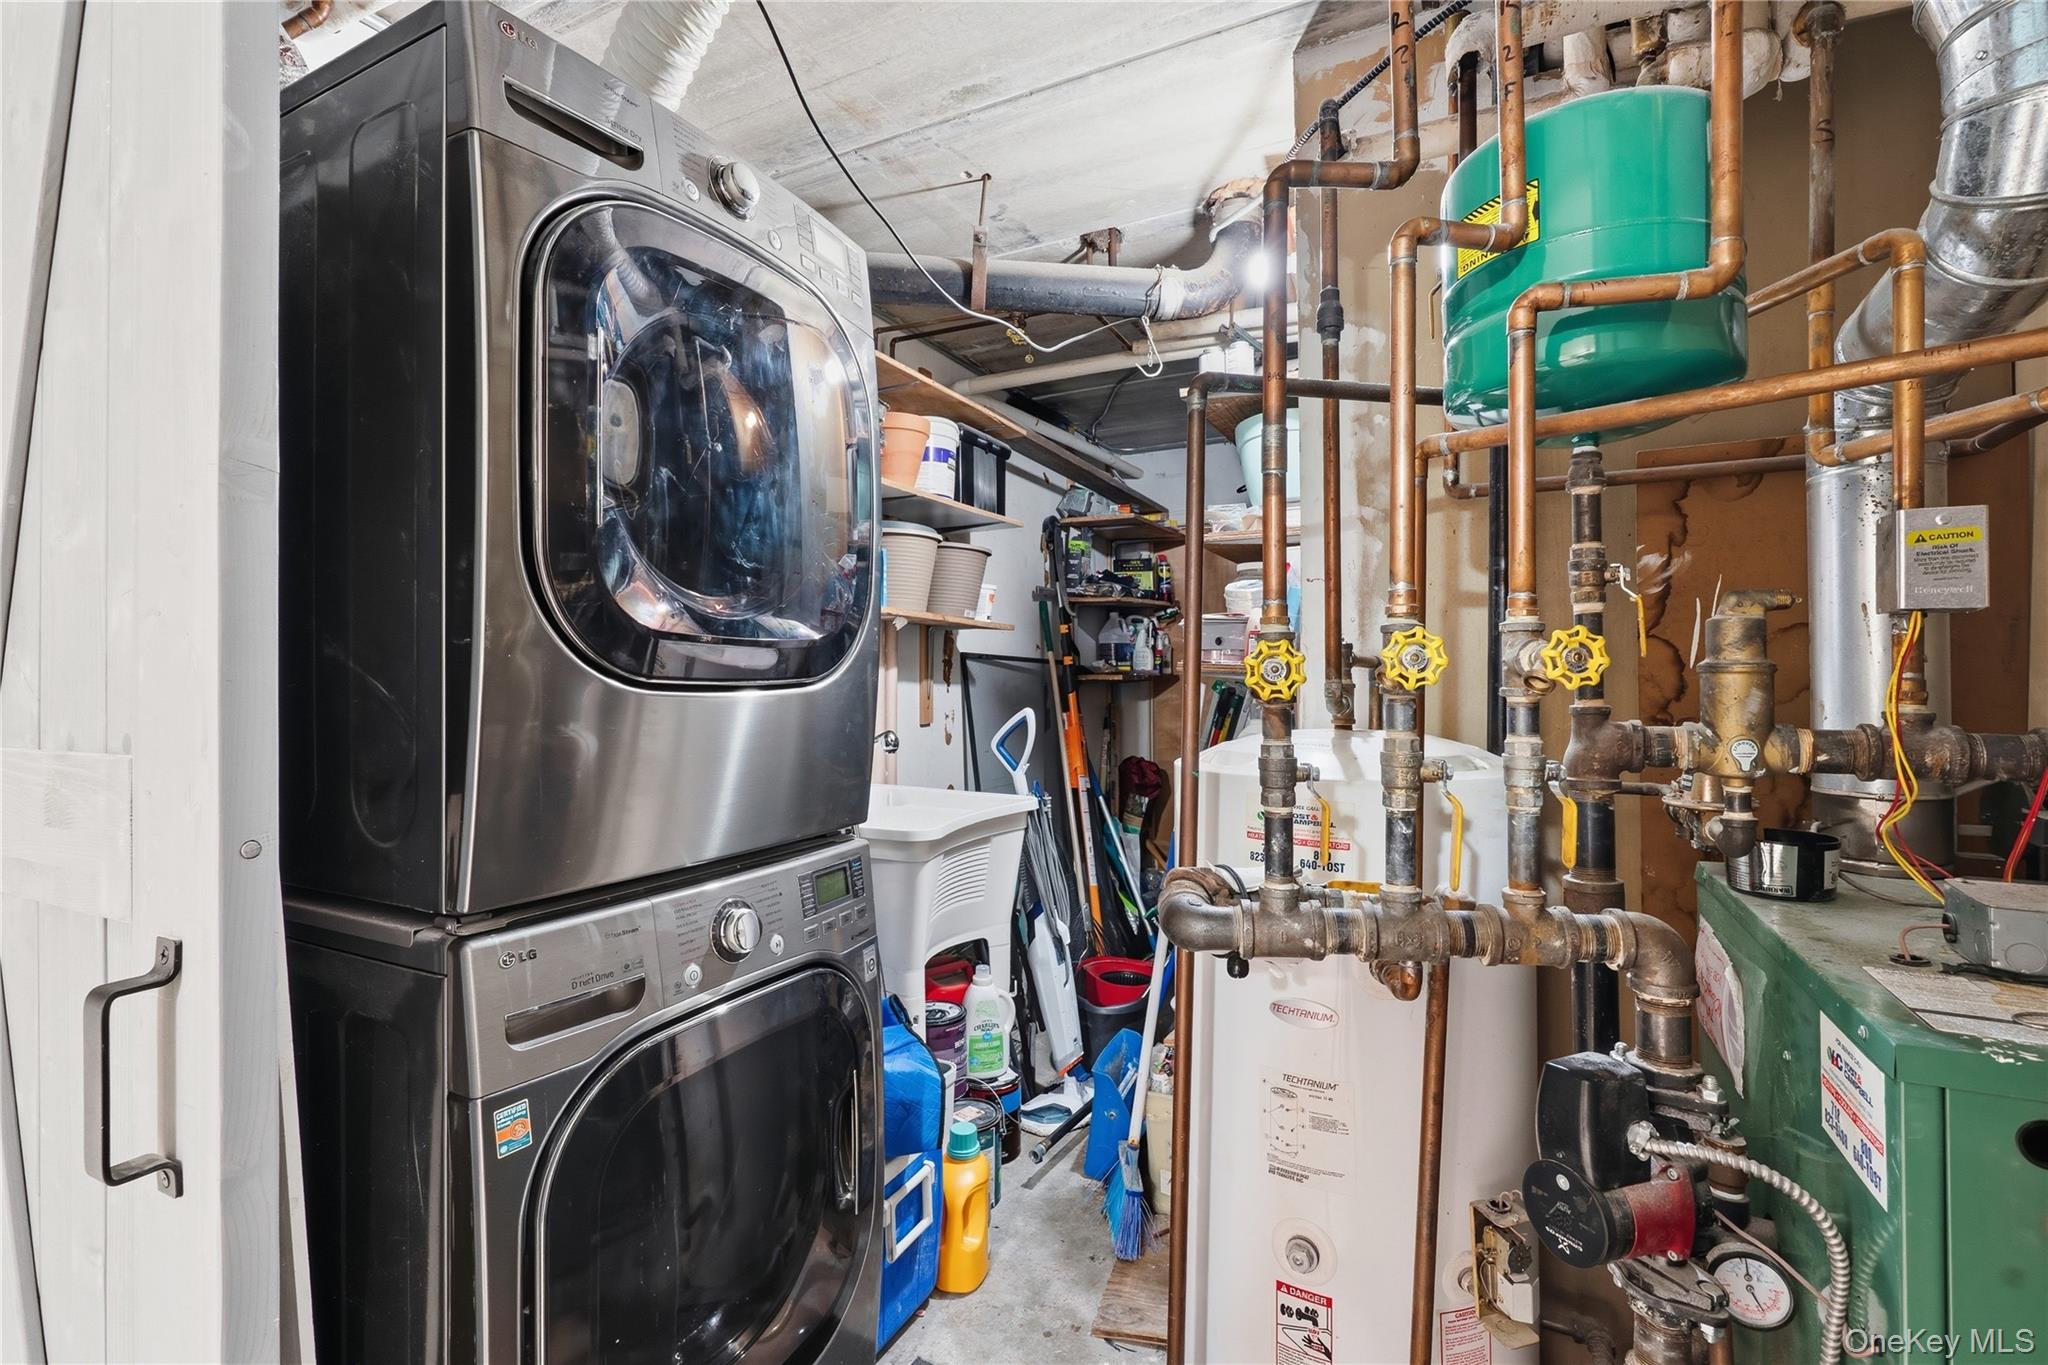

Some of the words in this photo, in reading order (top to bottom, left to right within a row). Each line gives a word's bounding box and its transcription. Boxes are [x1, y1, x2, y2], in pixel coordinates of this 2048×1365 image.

[1502, 45, 1517, 62] 2
[1928, 531, 1974, 540] CAUTION
[1271, 1002, 1335, 1023] TECHTANIUM
[1282, 1072, 1338, 1091] TECHTANIUM
[1289, 1287, 1328, 1306] DANGER
